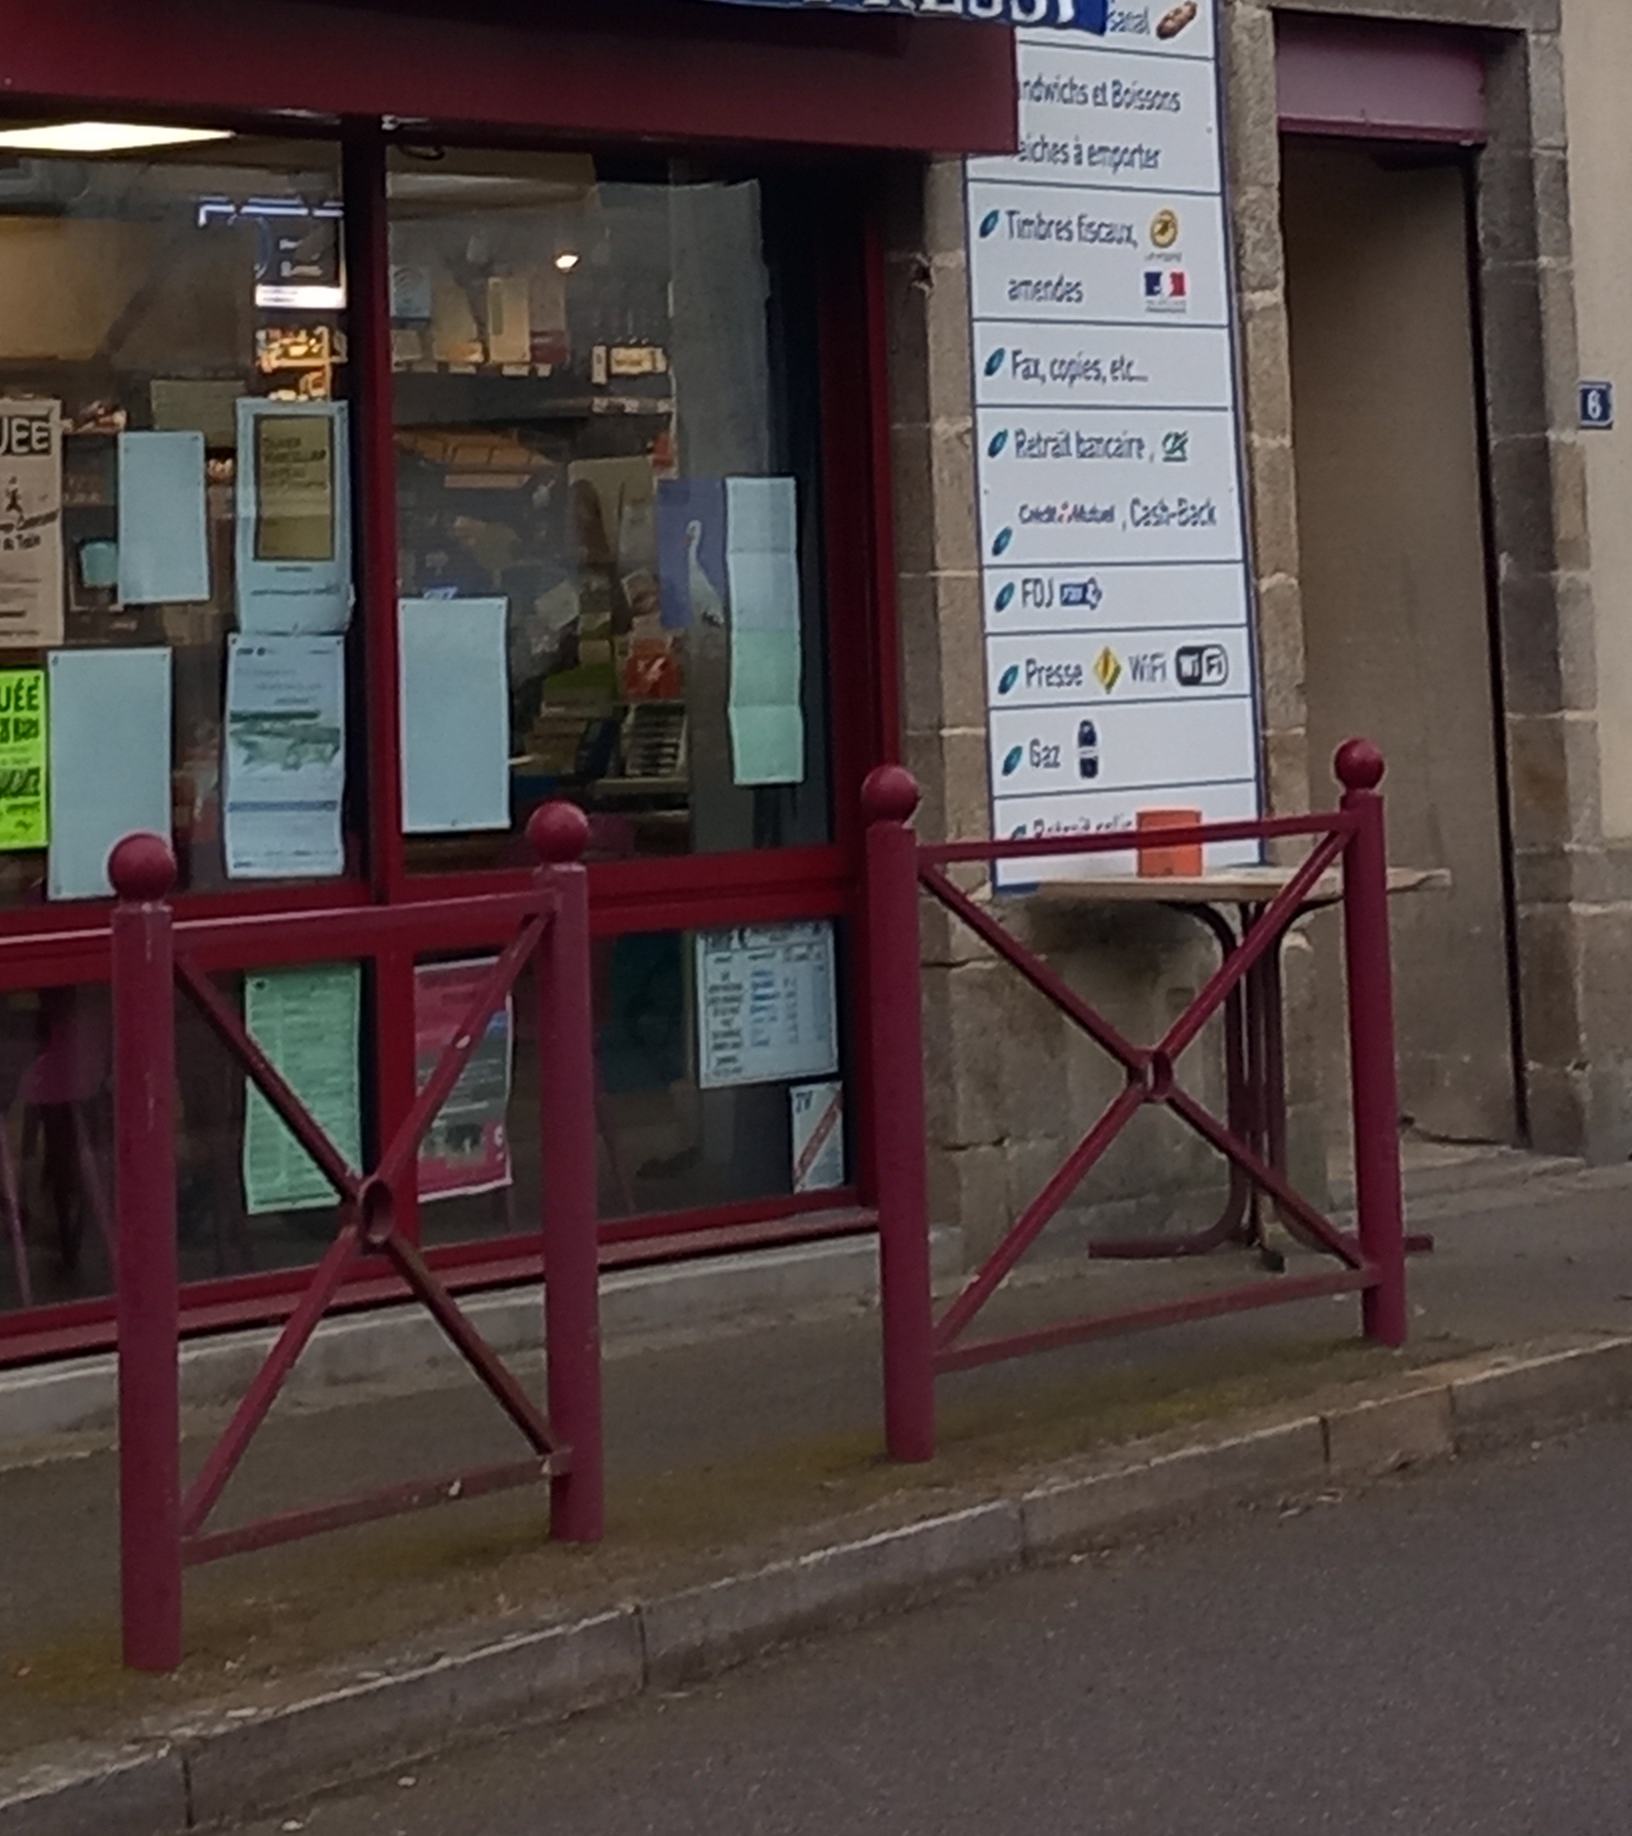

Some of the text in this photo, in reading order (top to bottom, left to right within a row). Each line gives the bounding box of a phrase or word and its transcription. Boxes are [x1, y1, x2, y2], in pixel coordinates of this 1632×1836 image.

[1092, 82, 1108, 107] et
[1111, 80, 1181, 112] Boissons
[1087, 144, 1161, 175] emporter
[1006, 209, 1073, 242] Timbres
[1007, 274, 1083, 303] amendes
[1587, 390, 1603, 419] 6
[1015, 428, 1073, 459] Retrait
[1021, 578, 1054, 609] FDJ
[1025, 658, 1084, 689] Presse
[1029, 738, 1061, 769] Gaz
